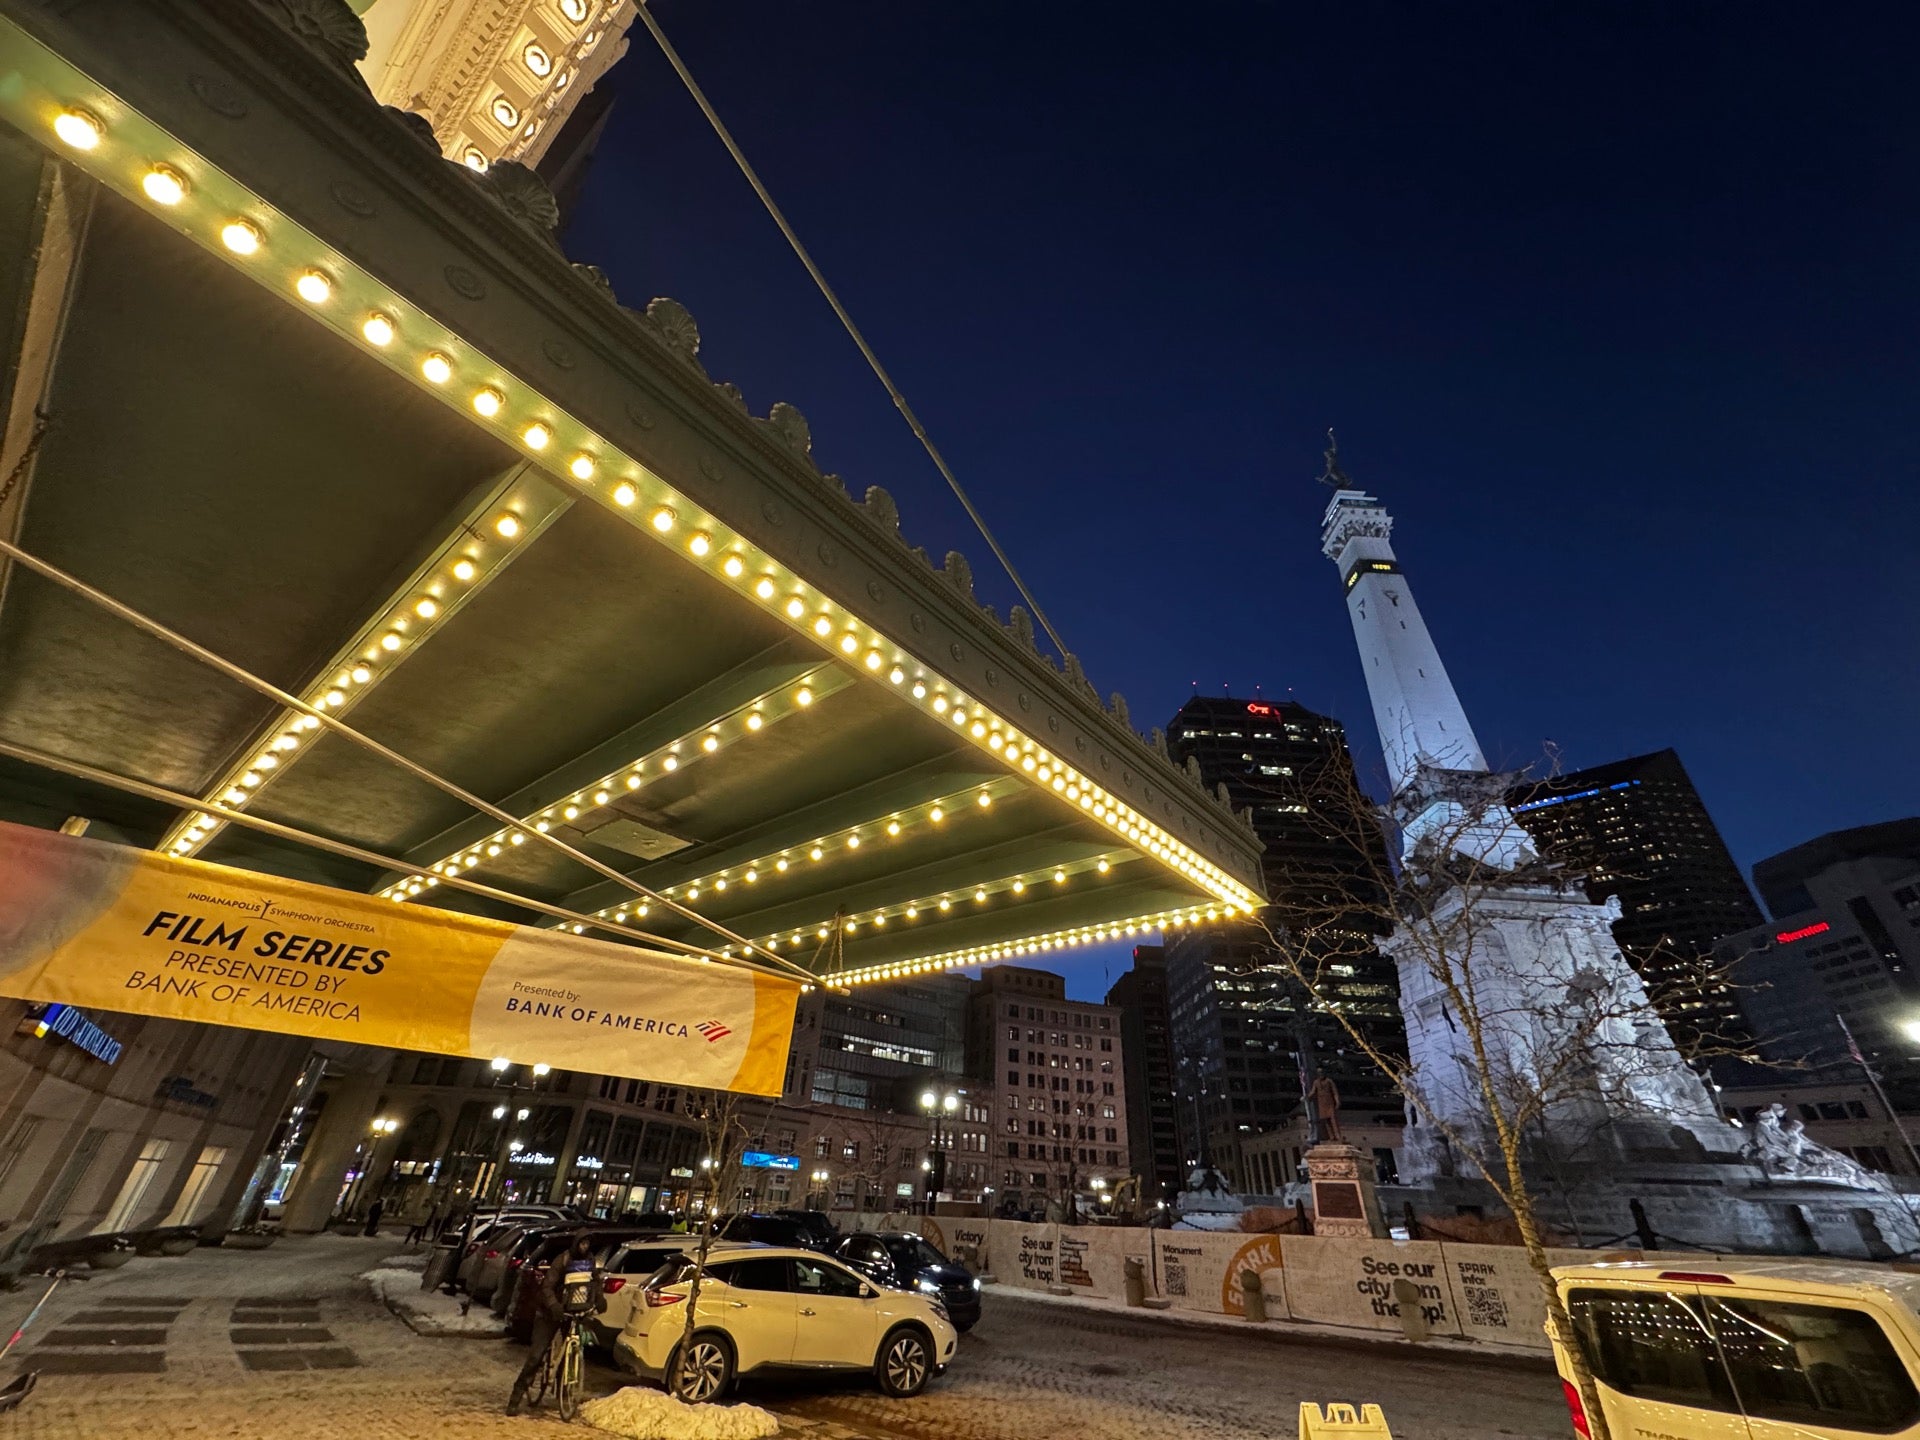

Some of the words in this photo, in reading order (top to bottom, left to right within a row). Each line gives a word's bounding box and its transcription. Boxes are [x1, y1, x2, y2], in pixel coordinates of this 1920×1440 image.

[187, 892, 262, 912] INDIANAPOLIS
[269, 907, 323, 924] SYMPHONY
[323, 917, 376, 934] ORCHESTRA
[142, 911, 249, 951] FILM
[253, 931, 391, 975] SERIES
[164, 950, 308, 988] PRESENTED
[314, 974, 347, 994] BY
[125, 970, 207, 998] BANK
[211, 984, 250, 1004] OF
[252, 991, 361, 1023] AMERICA
[512, 981, 566, 1000] Presented
[566, 990, 582, 1003] by:
[52, 1006, 81, 1037] OLD
[506, 997, 566, 1019] BANK
[571, 1008, 598, 1023] OF
[600, 1012, 689, 1038] AMERICA
[955, 1229, 985, 1246] Victory
[1022, 1236, 1038, 1249] See
[1039, 1240, 1054, 1251] our
[1019, 1250, 1033, 1267] city
[1162, 1244, 1203, 1256] Monument
[1023, 1264, 1036, 1279] the
[1361, 1256, 1400, 1276] See
[1402, 1263, 1436, 1278] our
[1458, 1262, 1496, 1276] SPARK
[1357, 1277, 1391, 1300] city
